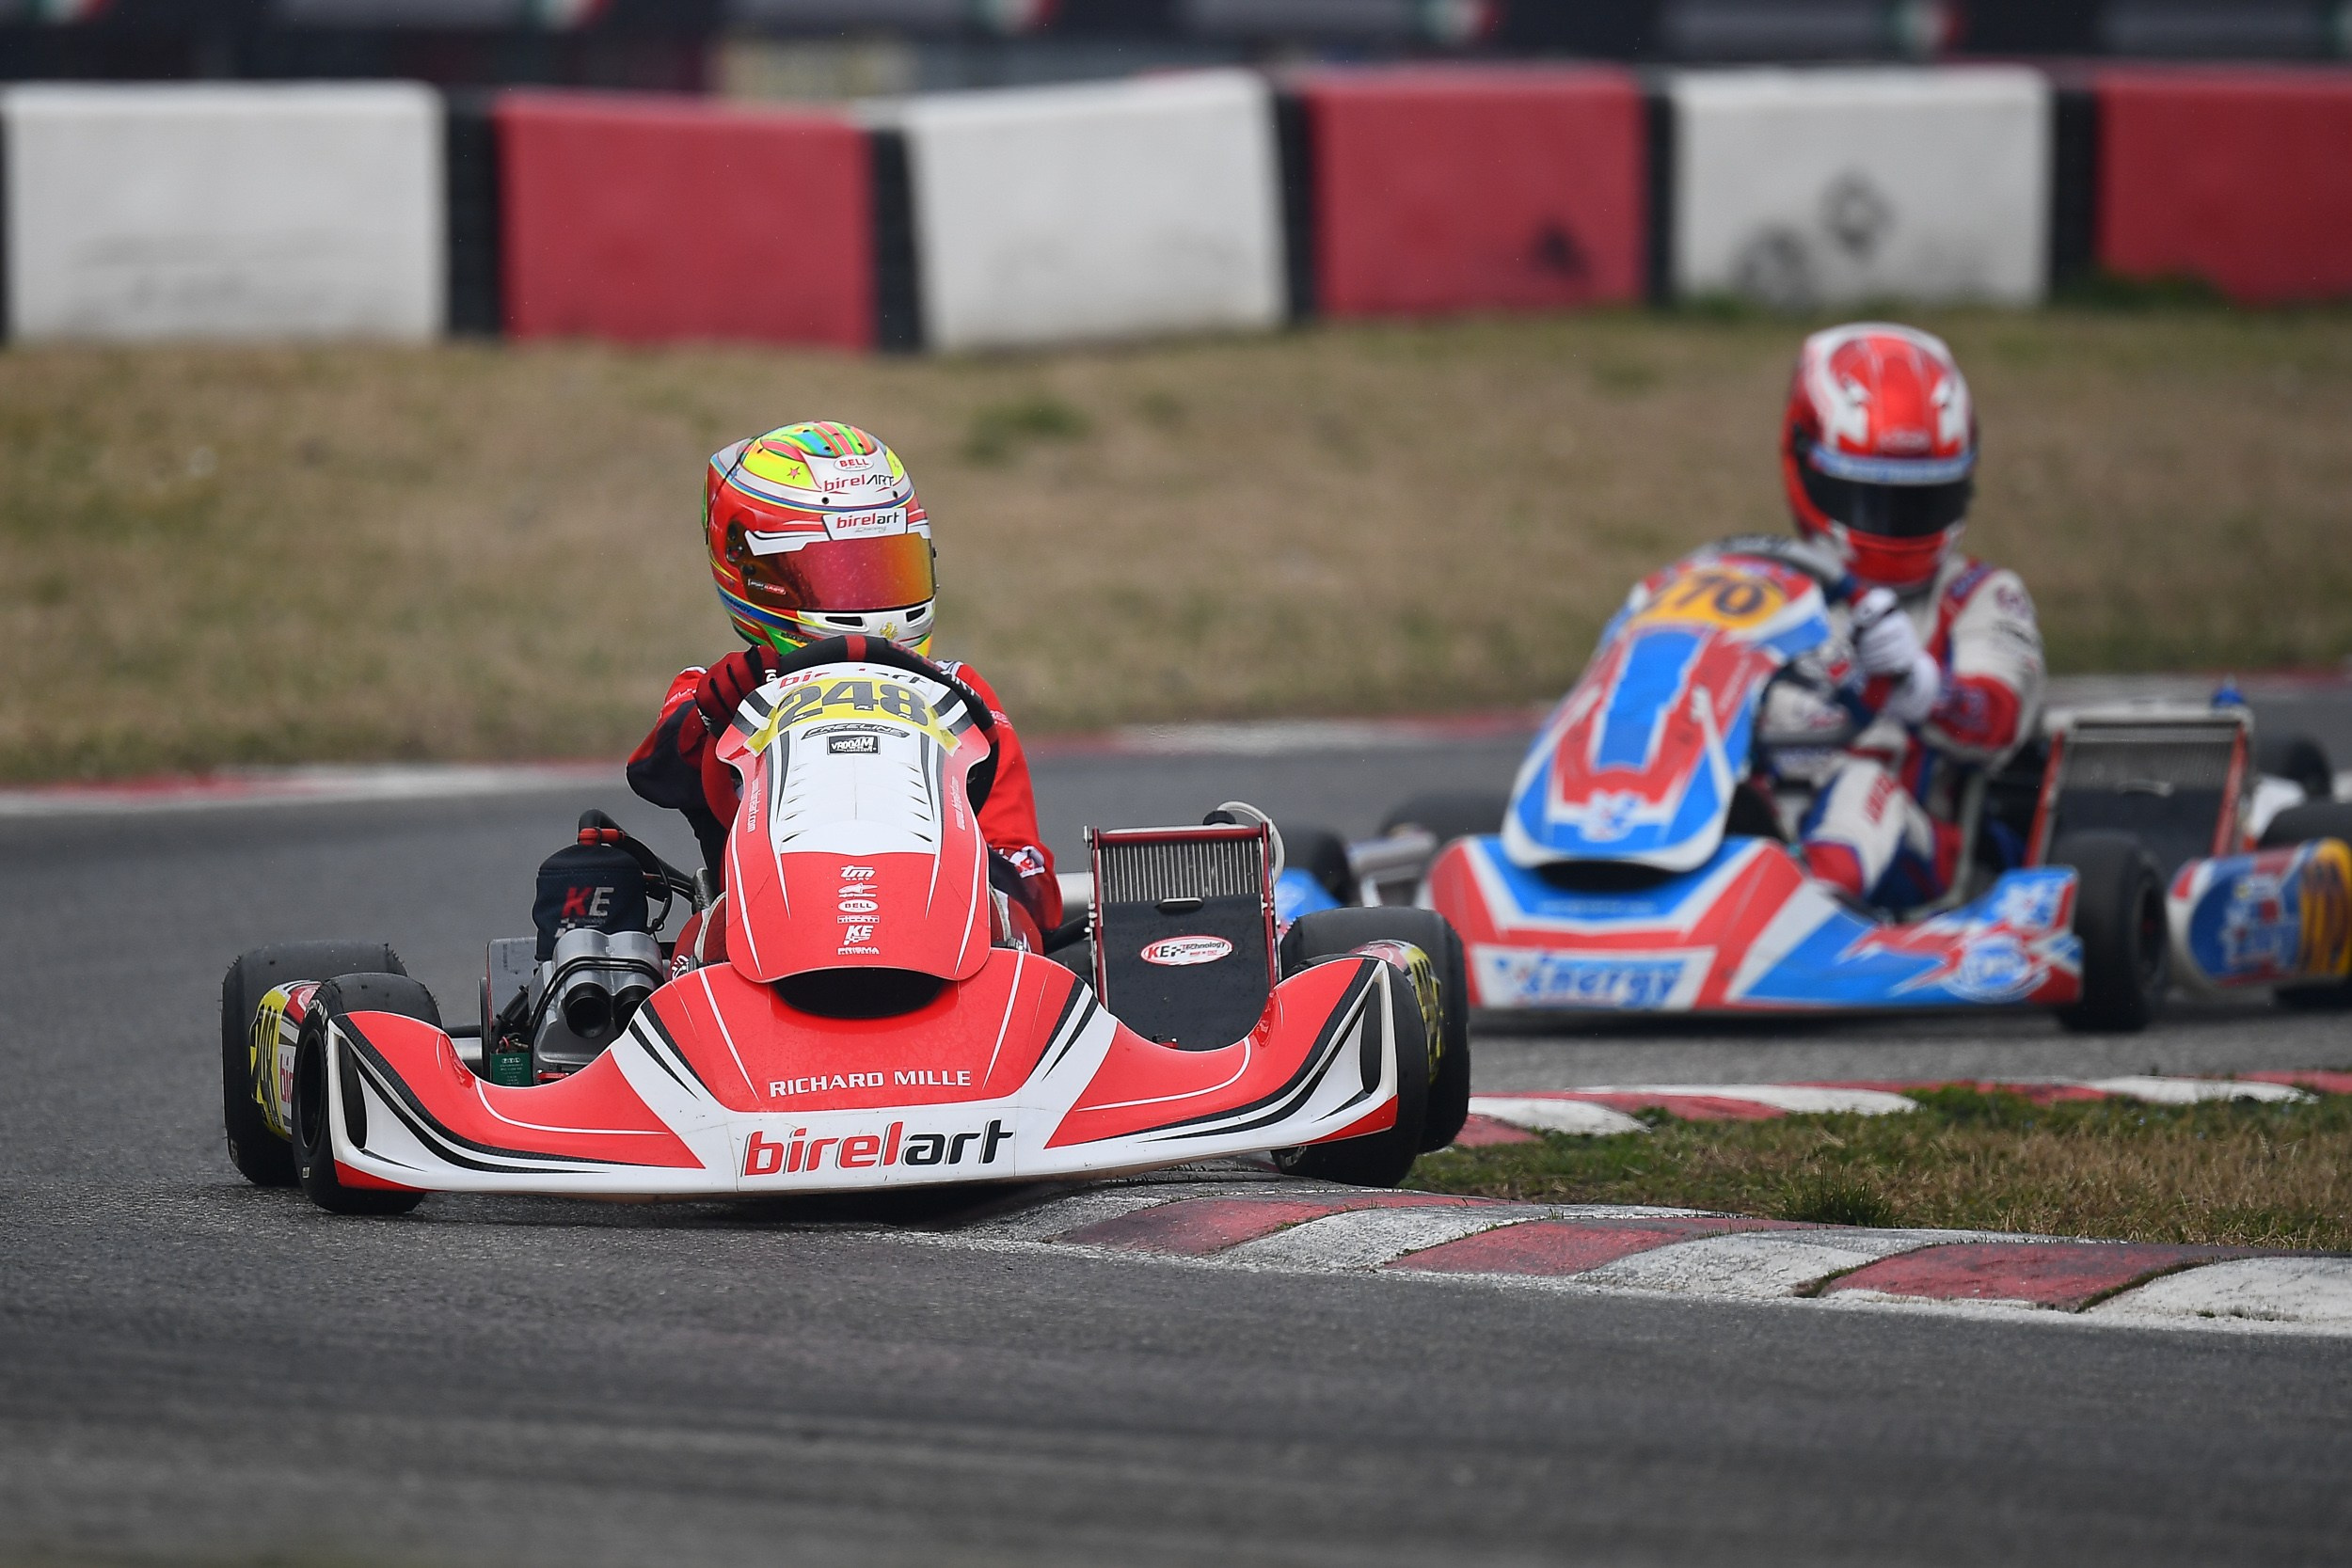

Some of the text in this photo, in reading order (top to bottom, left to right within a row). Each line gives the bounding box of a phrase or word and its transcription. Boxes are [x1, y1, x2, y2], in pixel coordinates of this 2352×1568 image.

[839, 458, 869, 467] BELL
[836, 511, 899, 529] birelart
[777, 680, 930, 733] 248
[561, 886, 614, 918] KE
[846, 925, 874, 939] KE
[1147, 945, 1169, 959] KE
[769, 1069, 972, 1098] RICHARD MILLE
[739, 1118, 1015, 1179] birelart
